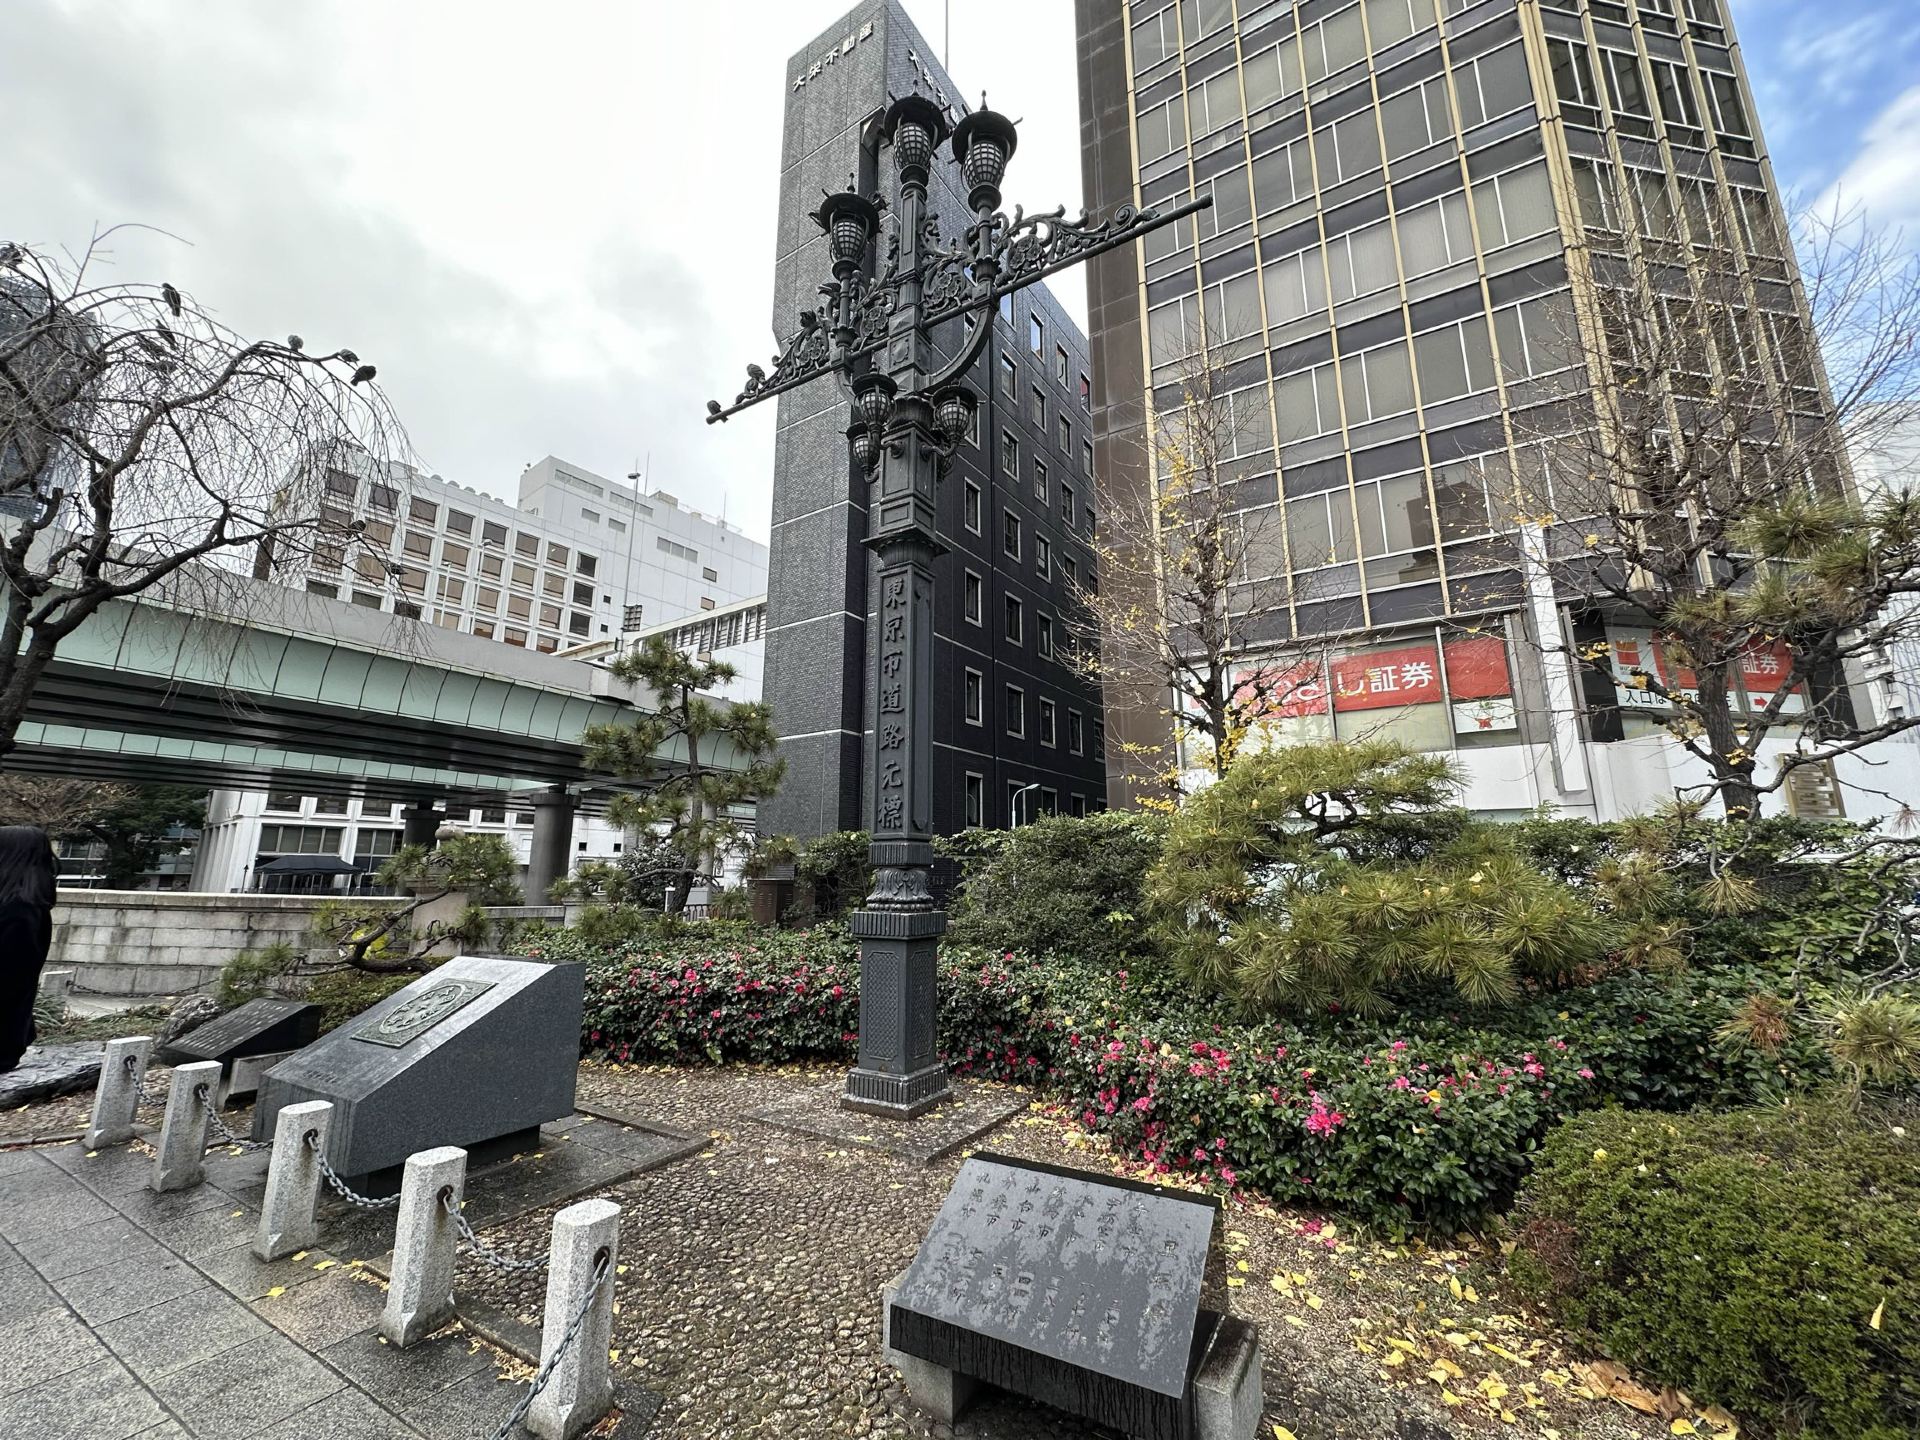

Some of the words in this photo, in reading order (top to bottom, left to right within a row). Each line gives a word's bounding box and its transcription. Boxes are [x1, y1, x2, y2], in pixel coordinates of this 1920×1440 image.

[793, 21, 874, 93] 大栄不動産
[879, 578, 906, 828] 東京市道路元標
